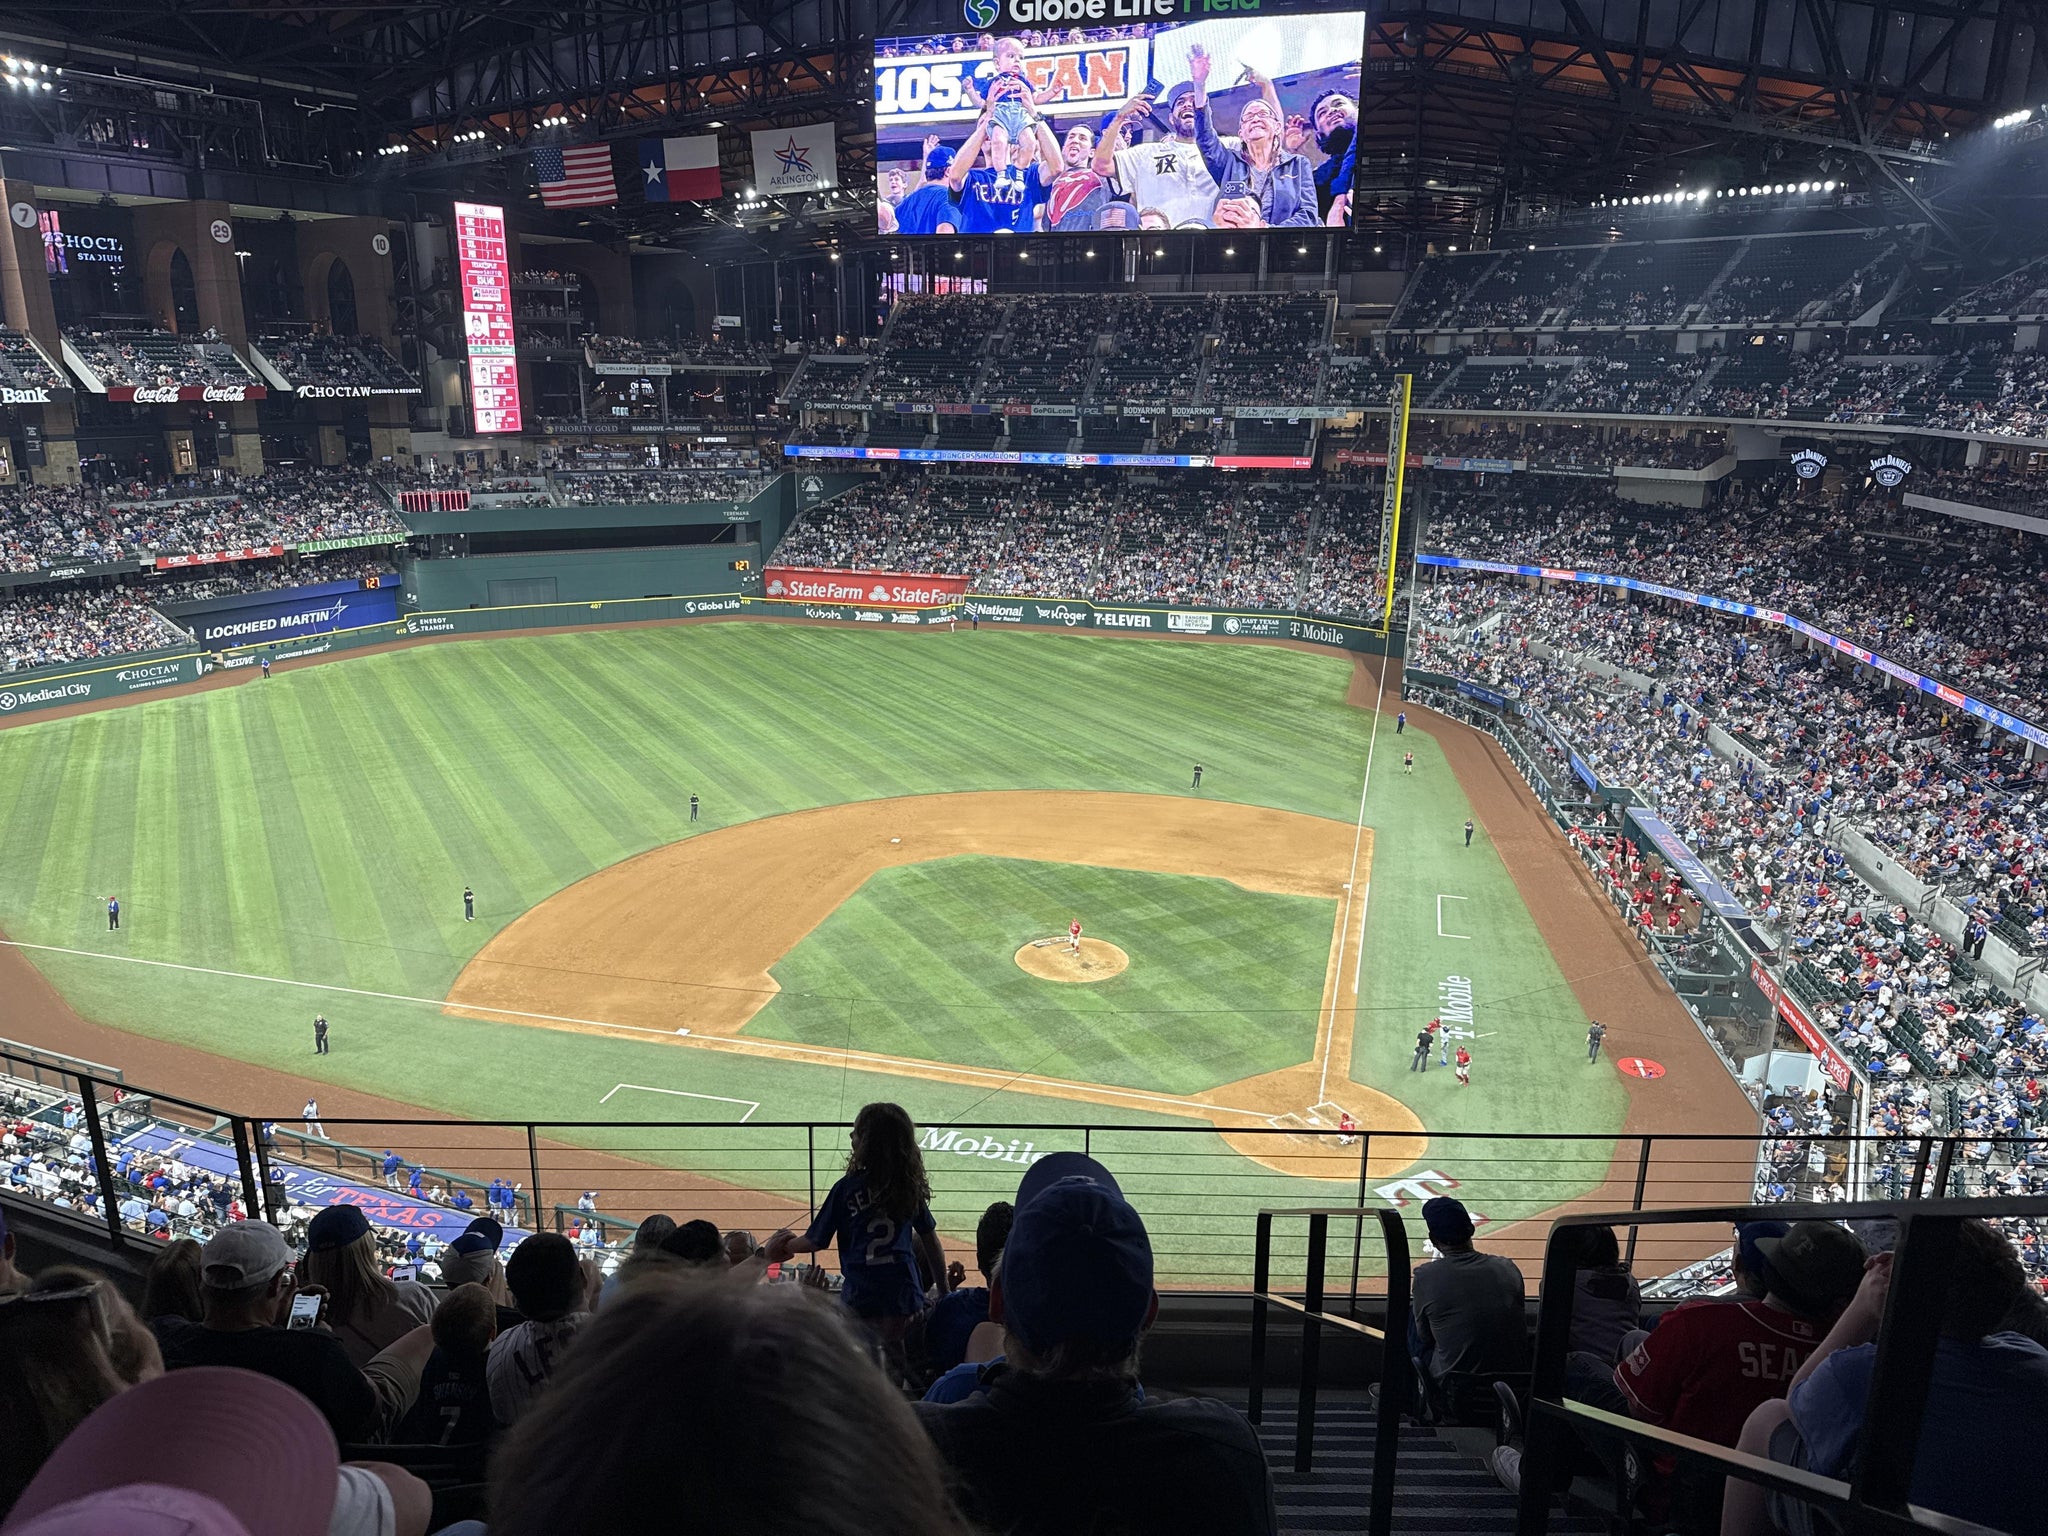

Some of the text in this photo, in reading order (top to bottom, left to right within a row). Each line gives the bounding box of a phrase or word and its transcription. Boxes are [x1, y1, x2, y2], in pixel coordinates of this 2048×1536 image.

[1009, 0, 1104, 23] Globe
[1113, 0, 1173, 17] Life
[770, 173, 819, 186] ARLINGTON
[19, 208, 28, 222] 7
[213, 225, 229, 237] 29
[376, 238, 386, 250] 10
[3, 387, 51, 403] Bank
[305, 385, 371, 398] CHOCTAW
[912, 404, 933, 412] 105.3
[1124, 407, 1165, 415] BODYARMOR
[555, 424, 618, 433] PRIORITY GOLD
[1791, 451, 1806, 464] JACK
[1870, 457, 1887, 470] JACK
[308, 533, 404, 549] LUXOR STAFFING
[168, 556, 187, 564] DEX
[197, 553, 217, 561] DEX
[226, 550, 244, 558] DEX
[49, 568, 85, 577] ARENA
[698, 600, 740, 611] Globe Life
[806, 608, 842, 620] Kubota
[1051, 606, 1086, 626] Kroger
[206, 610, 329, 640] LOCKHEED MARTIN
[1169, 616, 1180, 626] T
[421, 624, 454, 632] TRANSFER
[1290, 621, 1343, 644] T Mobile
[275, 649, 323, 660] LOCKHEED MARTIN
[122, 664, 180, 681] CHOCTAW
[19, 683, 91, 704] Medical City
[1438, 975, 1473, 1025] Mobile
[1830, 1058, 1849, 1085] SPEC'S
[302, 1176, 443, 1228] for TEXAS
[866, 1216, 895, 1266] 2
[1738, 1340, 1808, 1381] SEA
[440, 1406, 461, 1445] 7
